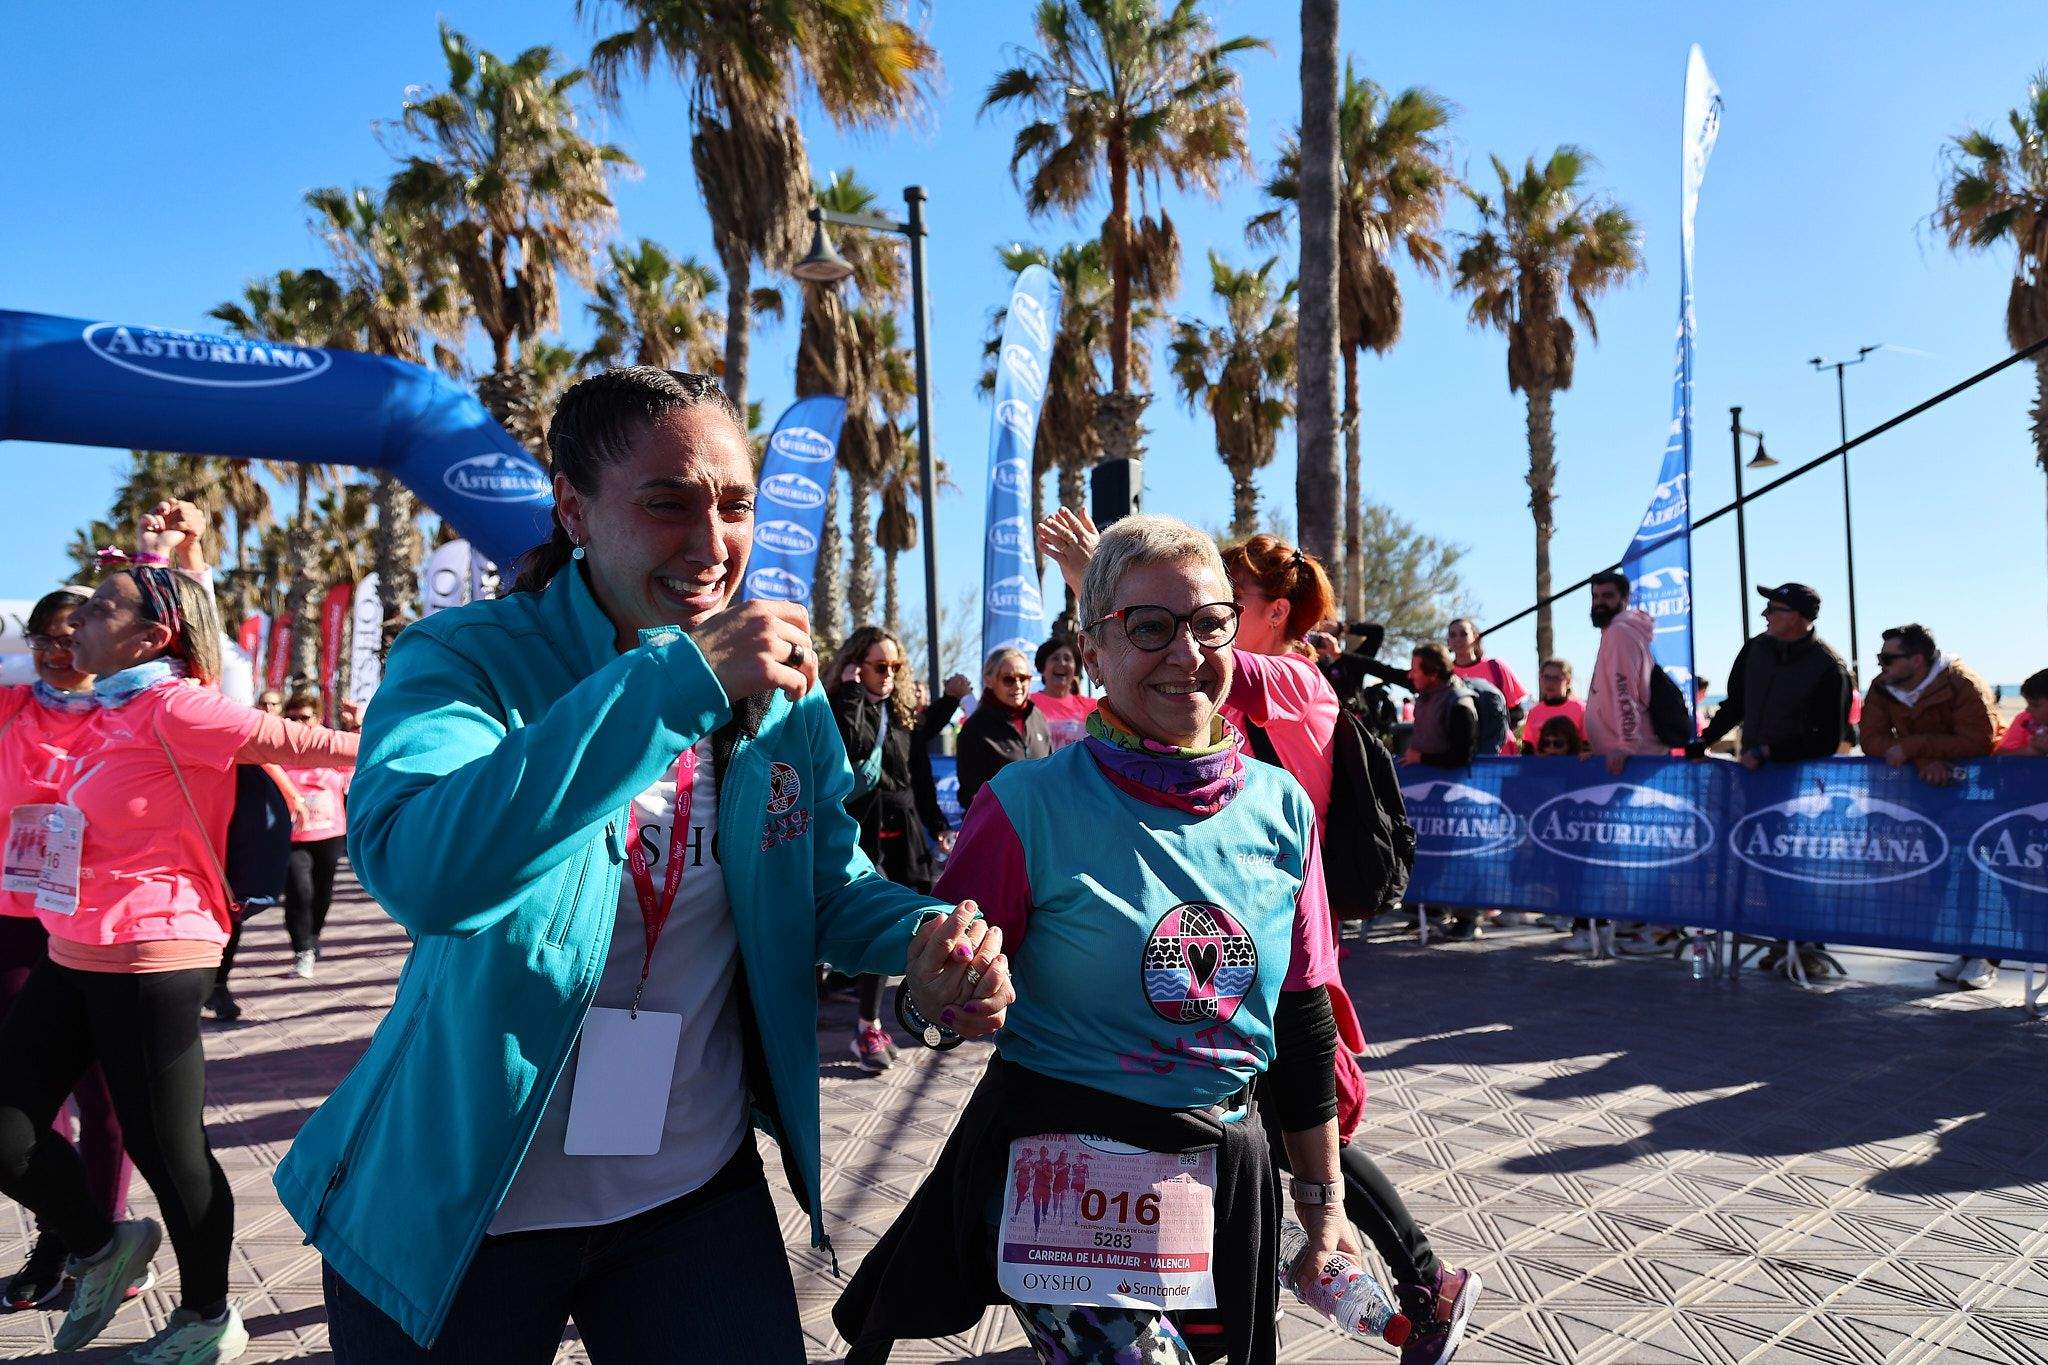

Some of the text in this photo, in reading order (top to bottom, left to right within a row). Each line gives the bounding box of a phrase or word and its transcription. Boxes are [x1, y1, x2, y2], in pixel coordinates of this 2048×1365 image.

[103, 326, 316, 370] ASTURIANA
[1542, 810, 1698, 849] ASTURIANA
[1745, 822, 1930, 863] ASTURIANA
[1989, 828, 2048, 869] AS
[1081, 1189, 1161, 1225] 016
[1093, 1232, 1132, 1249] 5283
[1028, 1249, 1191, 1269] CARRERA DE LA MUJER VALENCIA
[1023, 1273, 1092, 1292] OYSHO
[1133, 1282, 1191, 1297] Santander
